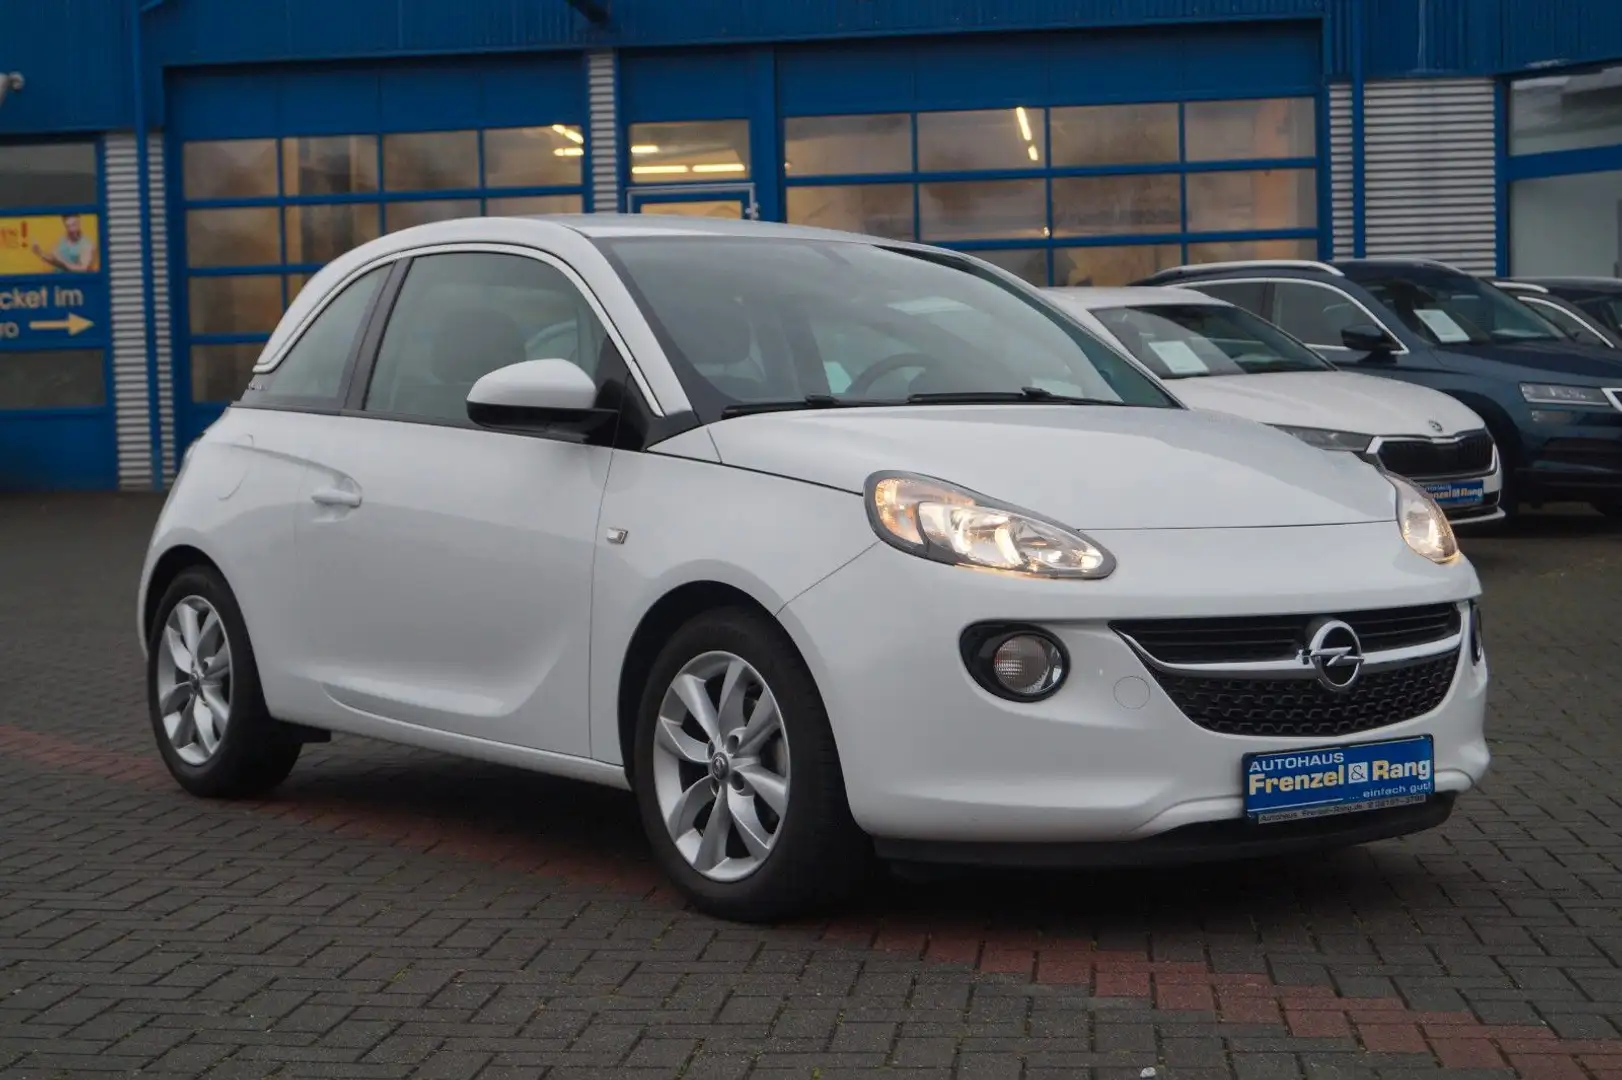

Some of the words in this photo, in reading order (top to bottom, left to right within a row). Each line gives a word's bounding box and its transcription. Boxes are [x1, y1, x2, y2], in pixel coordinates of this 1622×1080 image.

[54, 285, 84, 307] im
[1461, 487, 1483, 499] Rang
[1249, 752, 1344, 773] AUTOHAUS
[1249, 765, 1344, 795] Frenzel
[1350, 763, 1367, 783] &
[1372, 759, 1431, 781] Rang
[1362, 785, 1406, 798] einfach
[1409, 782, 1432, 794] gut!
